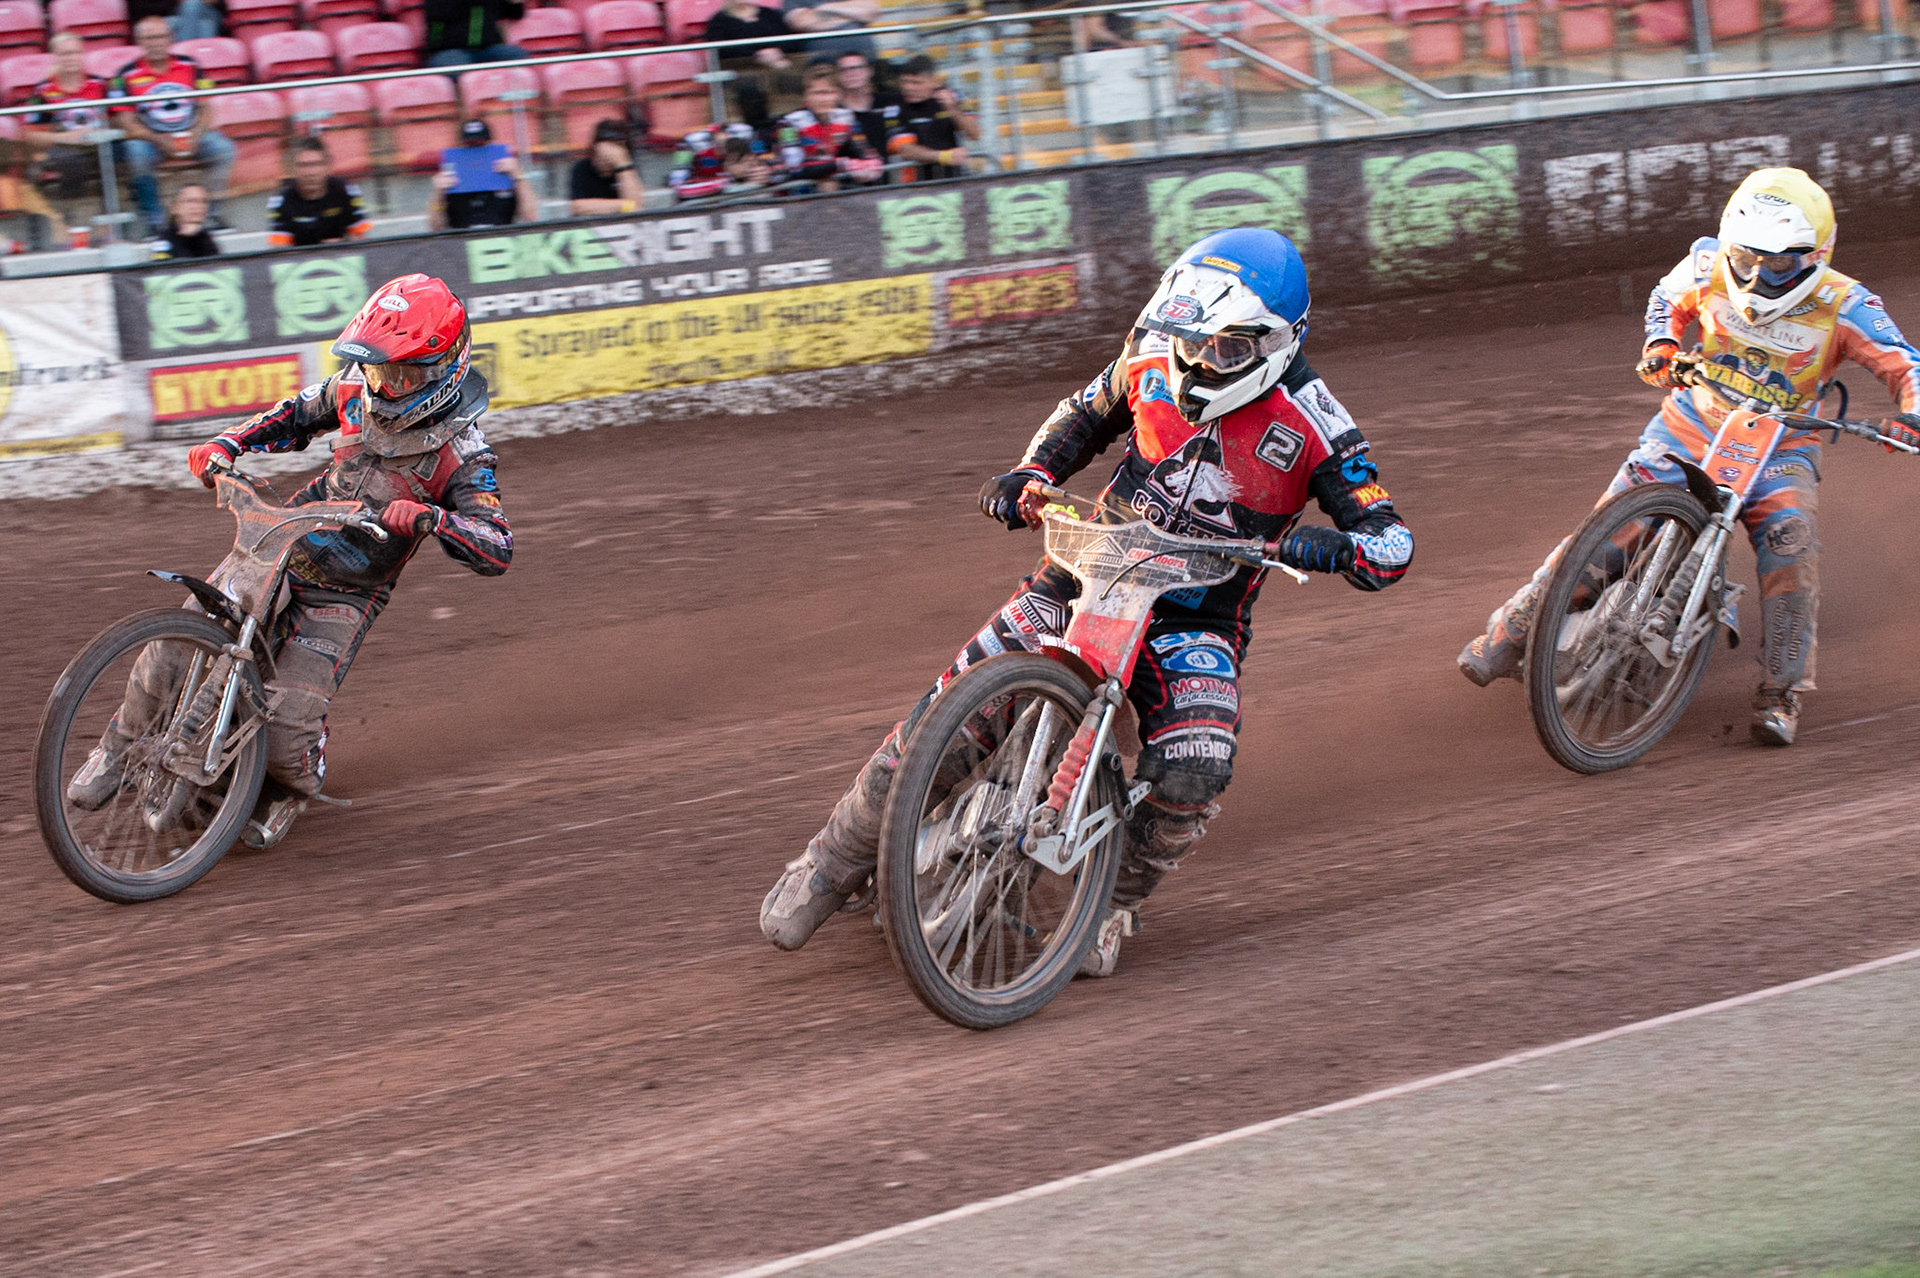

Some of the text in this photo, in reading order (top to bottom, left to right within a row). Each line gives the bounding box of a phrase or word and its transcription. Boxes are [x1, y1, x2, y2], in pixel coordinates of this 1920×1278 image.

[465, 207, 785, 284] BIKERIGHT
[650, 267, 749, 298] YOUR
[1784, 301, 1819, 318] IGHT
[1261, 428, 1300, 468] 2
[1170, 677, 1238, 700] MOTIVE
